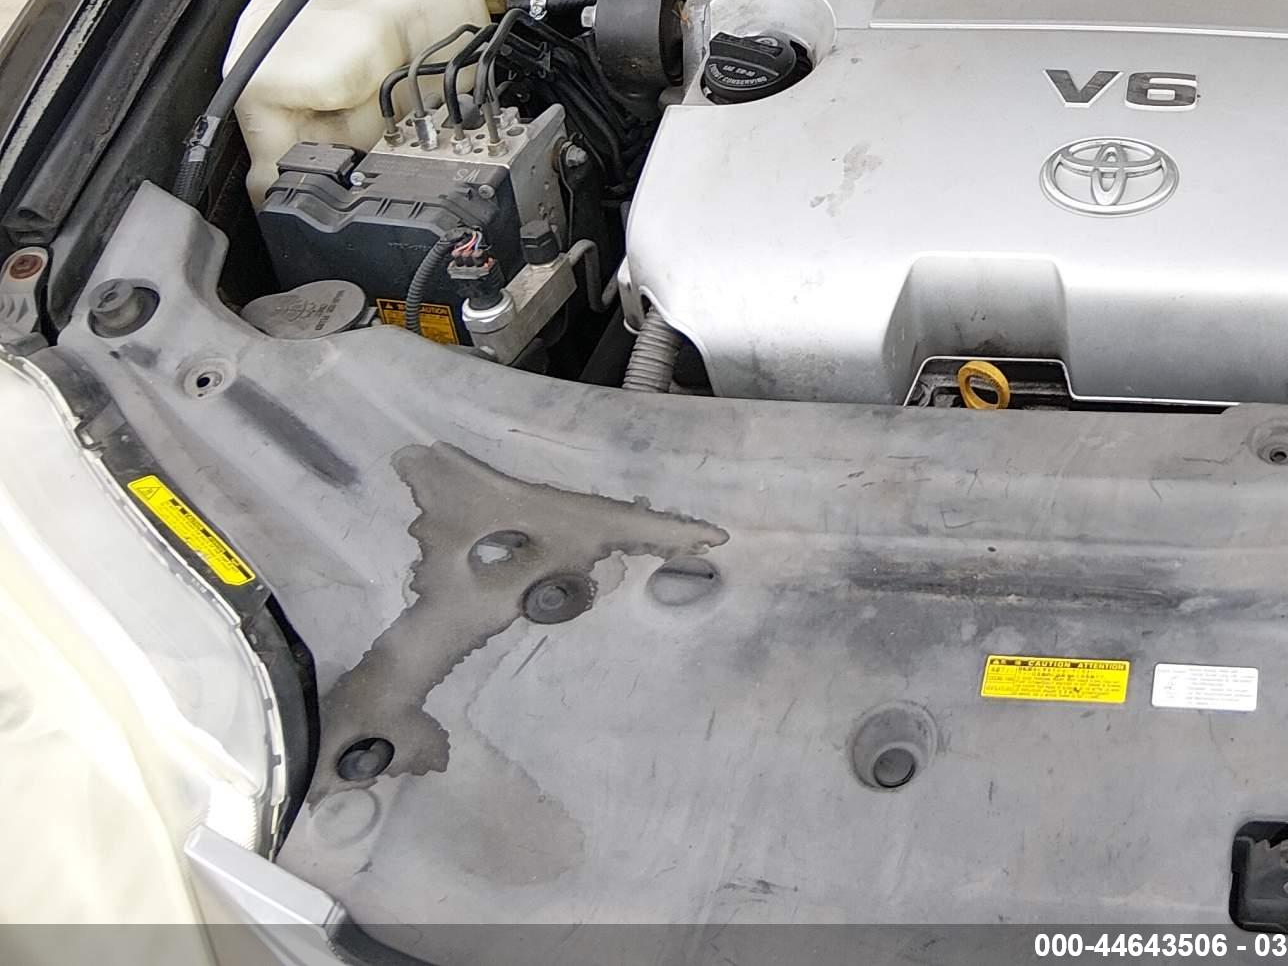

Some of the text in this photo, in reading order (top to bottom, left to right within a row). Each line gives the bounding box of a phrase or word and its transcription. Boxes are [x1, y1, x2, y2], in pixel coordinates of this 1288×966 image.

[1043, 69, 1198, 111] V6
[420, 306, 448, 315] AUTION
[1028, 660, 1071, 669] CAUTION
[1077, 663, 1126, 671] ATTENTION
